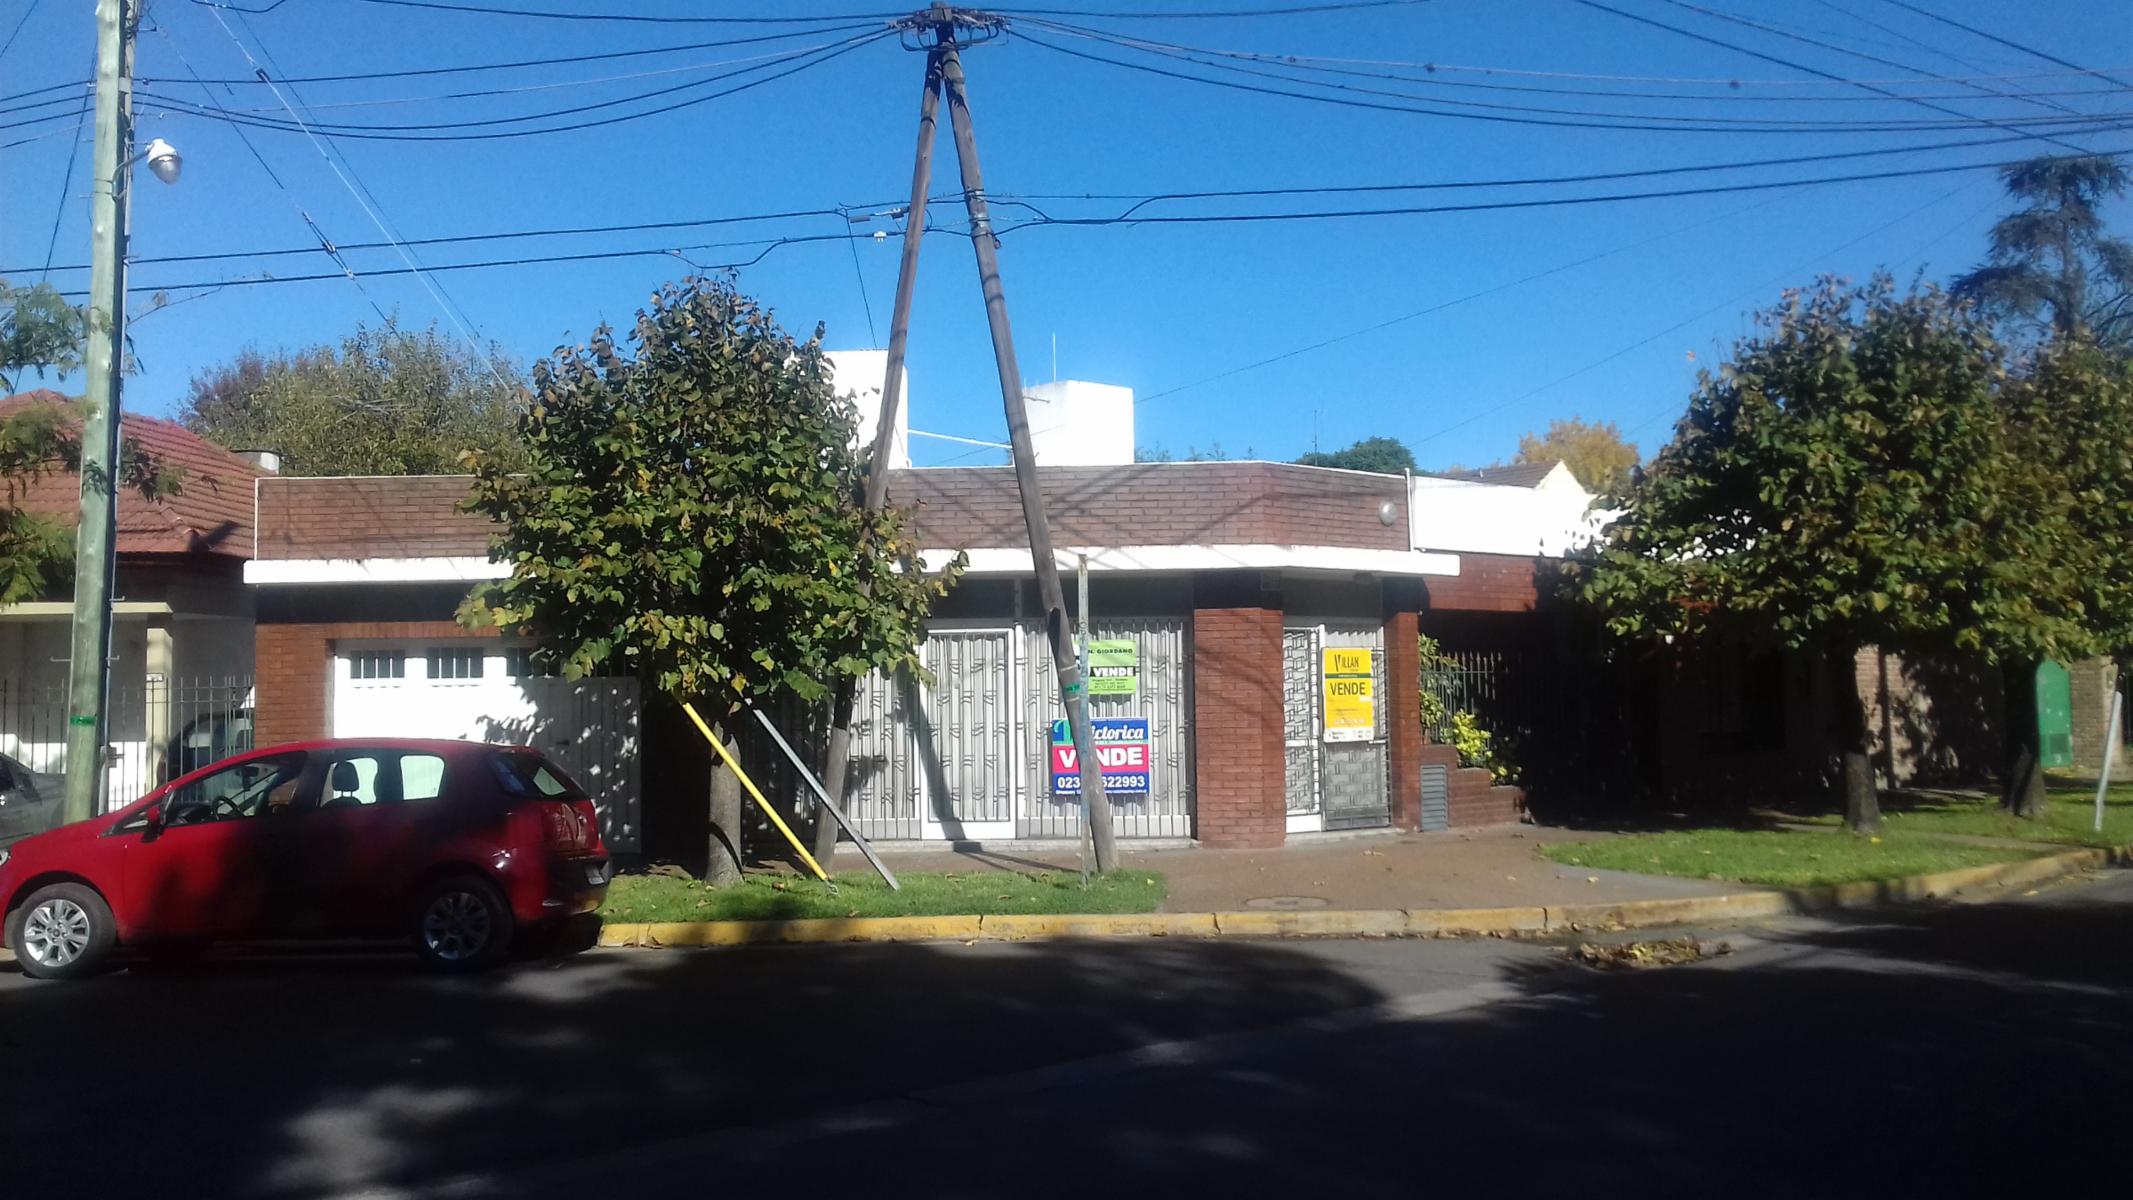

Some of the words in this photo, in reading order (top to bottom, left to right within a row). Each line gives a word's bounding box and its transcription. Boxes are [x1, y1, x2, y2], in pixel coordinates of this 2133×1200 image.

[1093, 667, 1134, 677] VENDE
[1330, 682, 1366, 696] VENDE
[1058, 747, 1144, 769] VNDE
